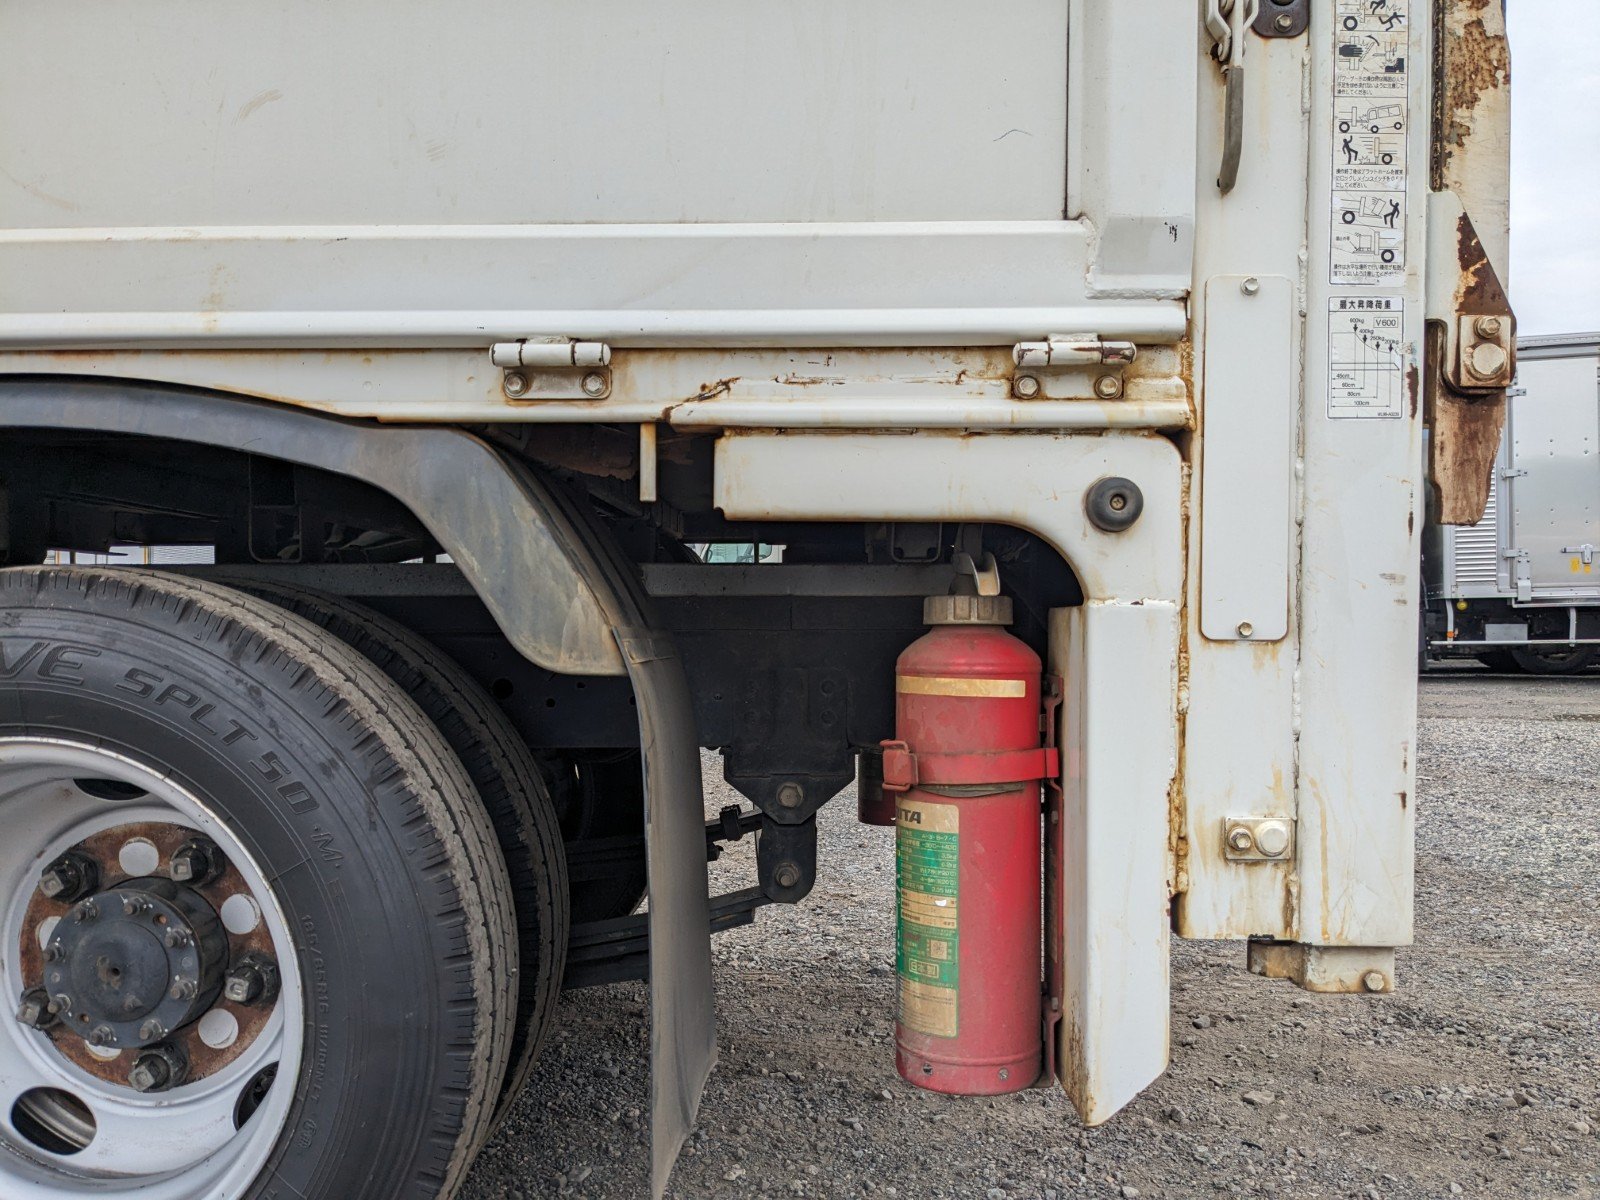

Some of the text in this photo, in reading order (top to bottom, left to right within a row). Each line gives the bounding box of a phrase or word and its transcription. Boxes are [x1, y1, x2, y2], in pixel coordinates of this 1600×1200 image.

[1339, 299, 1391, 310] 最大昇降荷重
[115, 666, 260, 747] SPLT
[249, 751, 321, 816] 50
